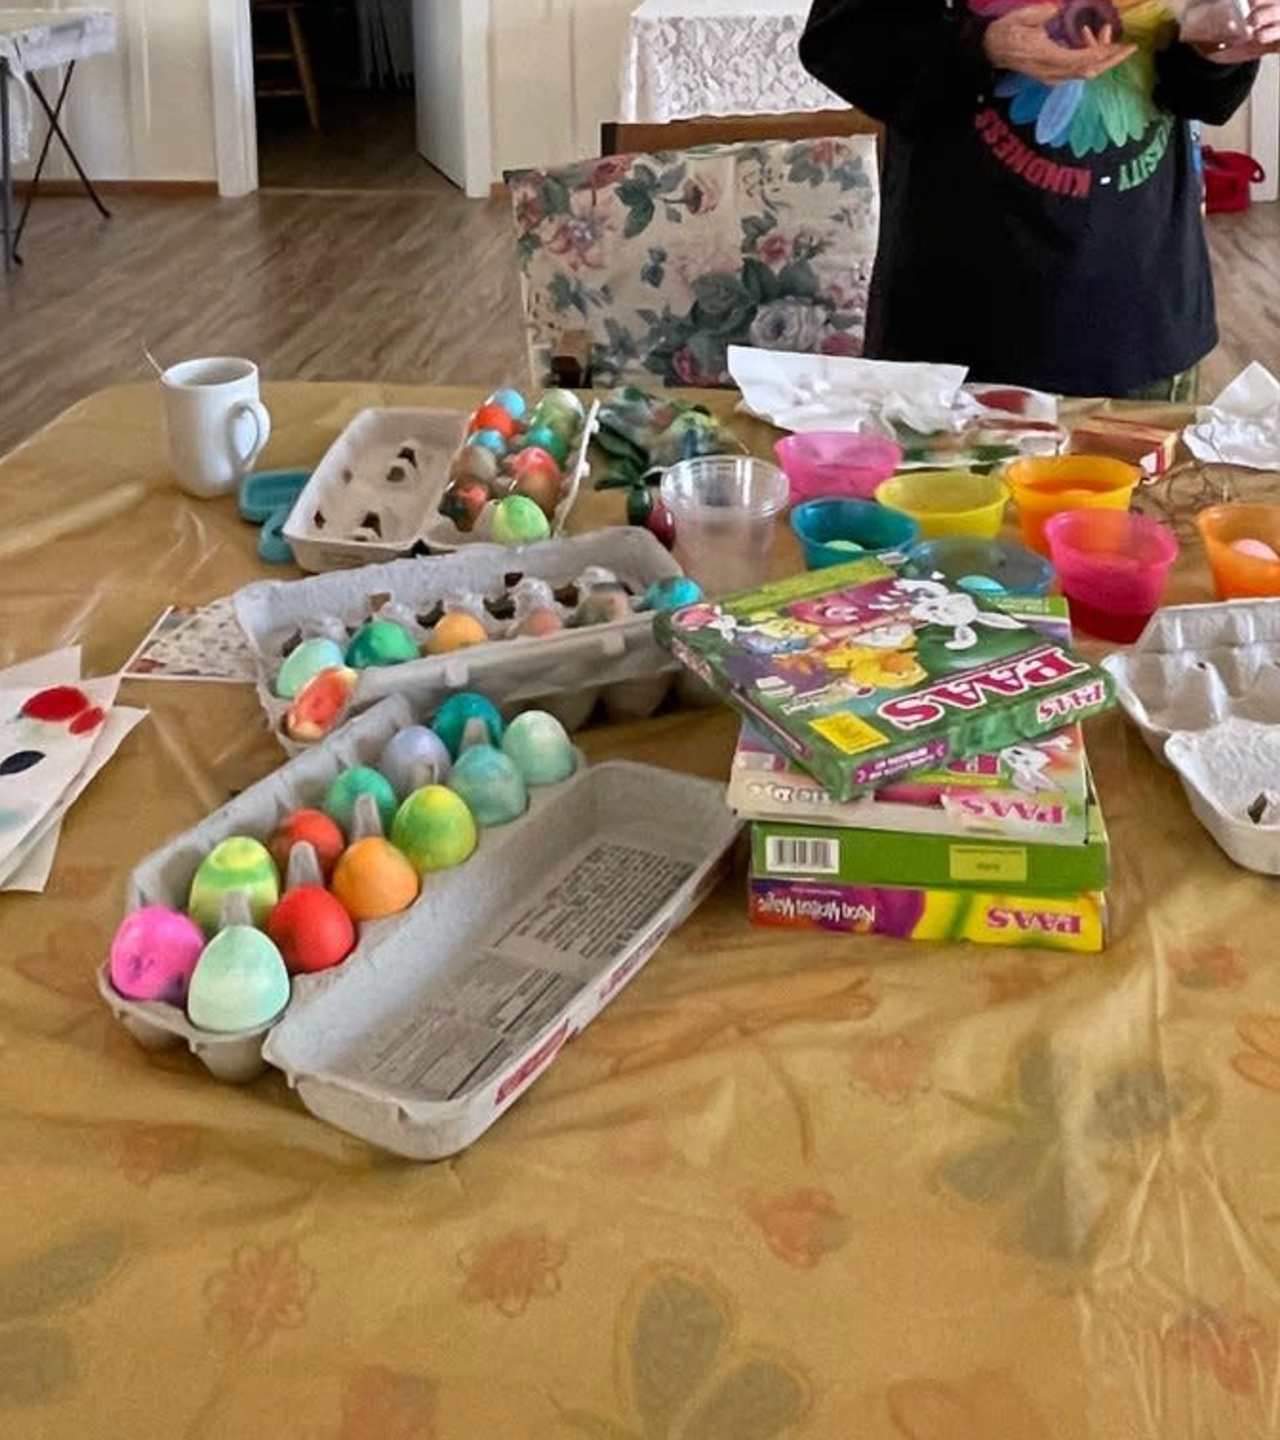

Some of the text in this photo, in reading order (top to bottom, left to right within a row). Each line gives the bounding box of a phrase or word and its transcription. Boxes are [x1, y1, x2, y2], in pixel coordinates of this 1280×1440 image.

[974, 106, 1092, 197] KINDNESS
[877, 645, 1091, 729] PAAS
[1036, 680, 1105, 724] PAAS
[960, 795, 1065, 825] PAAS
[985, 907, 1082, 935] PAAS
